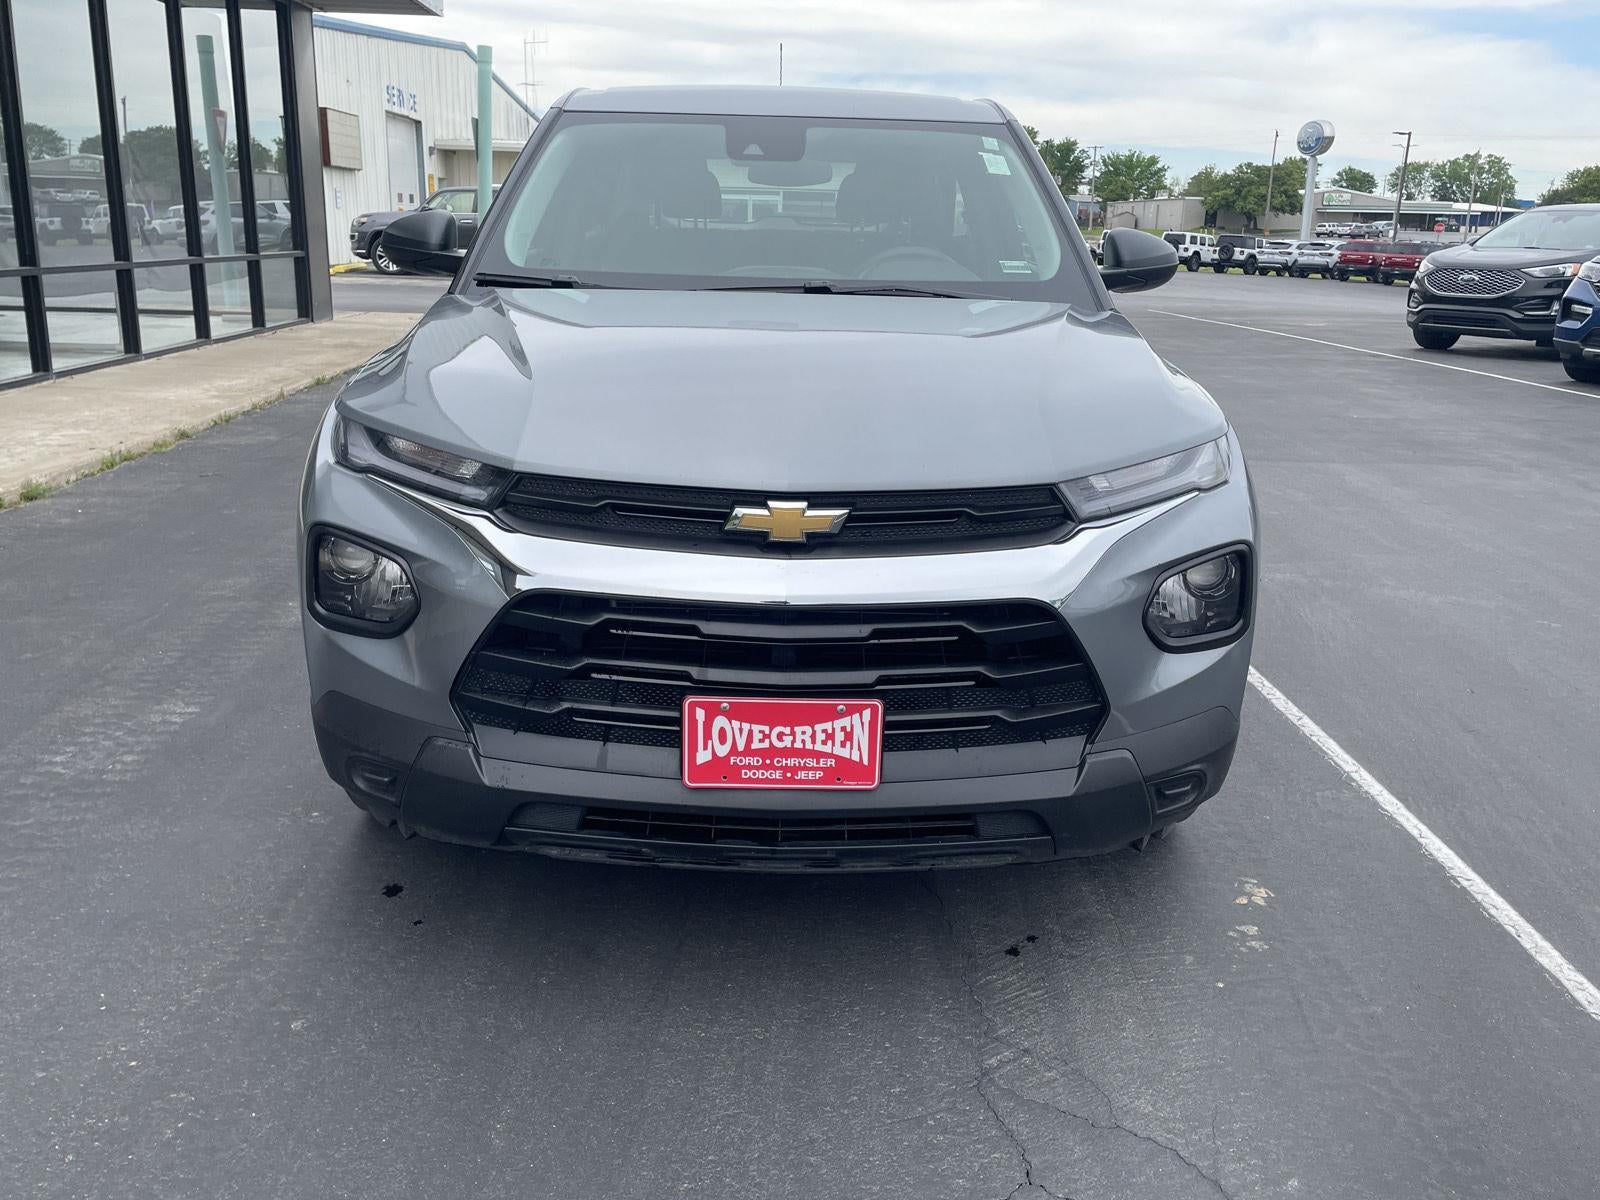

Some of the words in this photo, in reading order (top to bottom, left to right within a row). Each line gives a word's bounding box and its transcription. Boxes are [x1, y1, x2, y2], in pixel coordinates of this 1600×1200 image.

[386, 84, 417, 113] SERVCE
[695, 706, 871, 766] LOVEGREEN
[730, 756, 763, 766] FORD
[773, 757, 836, 767] CHRYSLER
[741, 769, 783, 779] DODGE
[794, 770, 824, 780] JEEP
